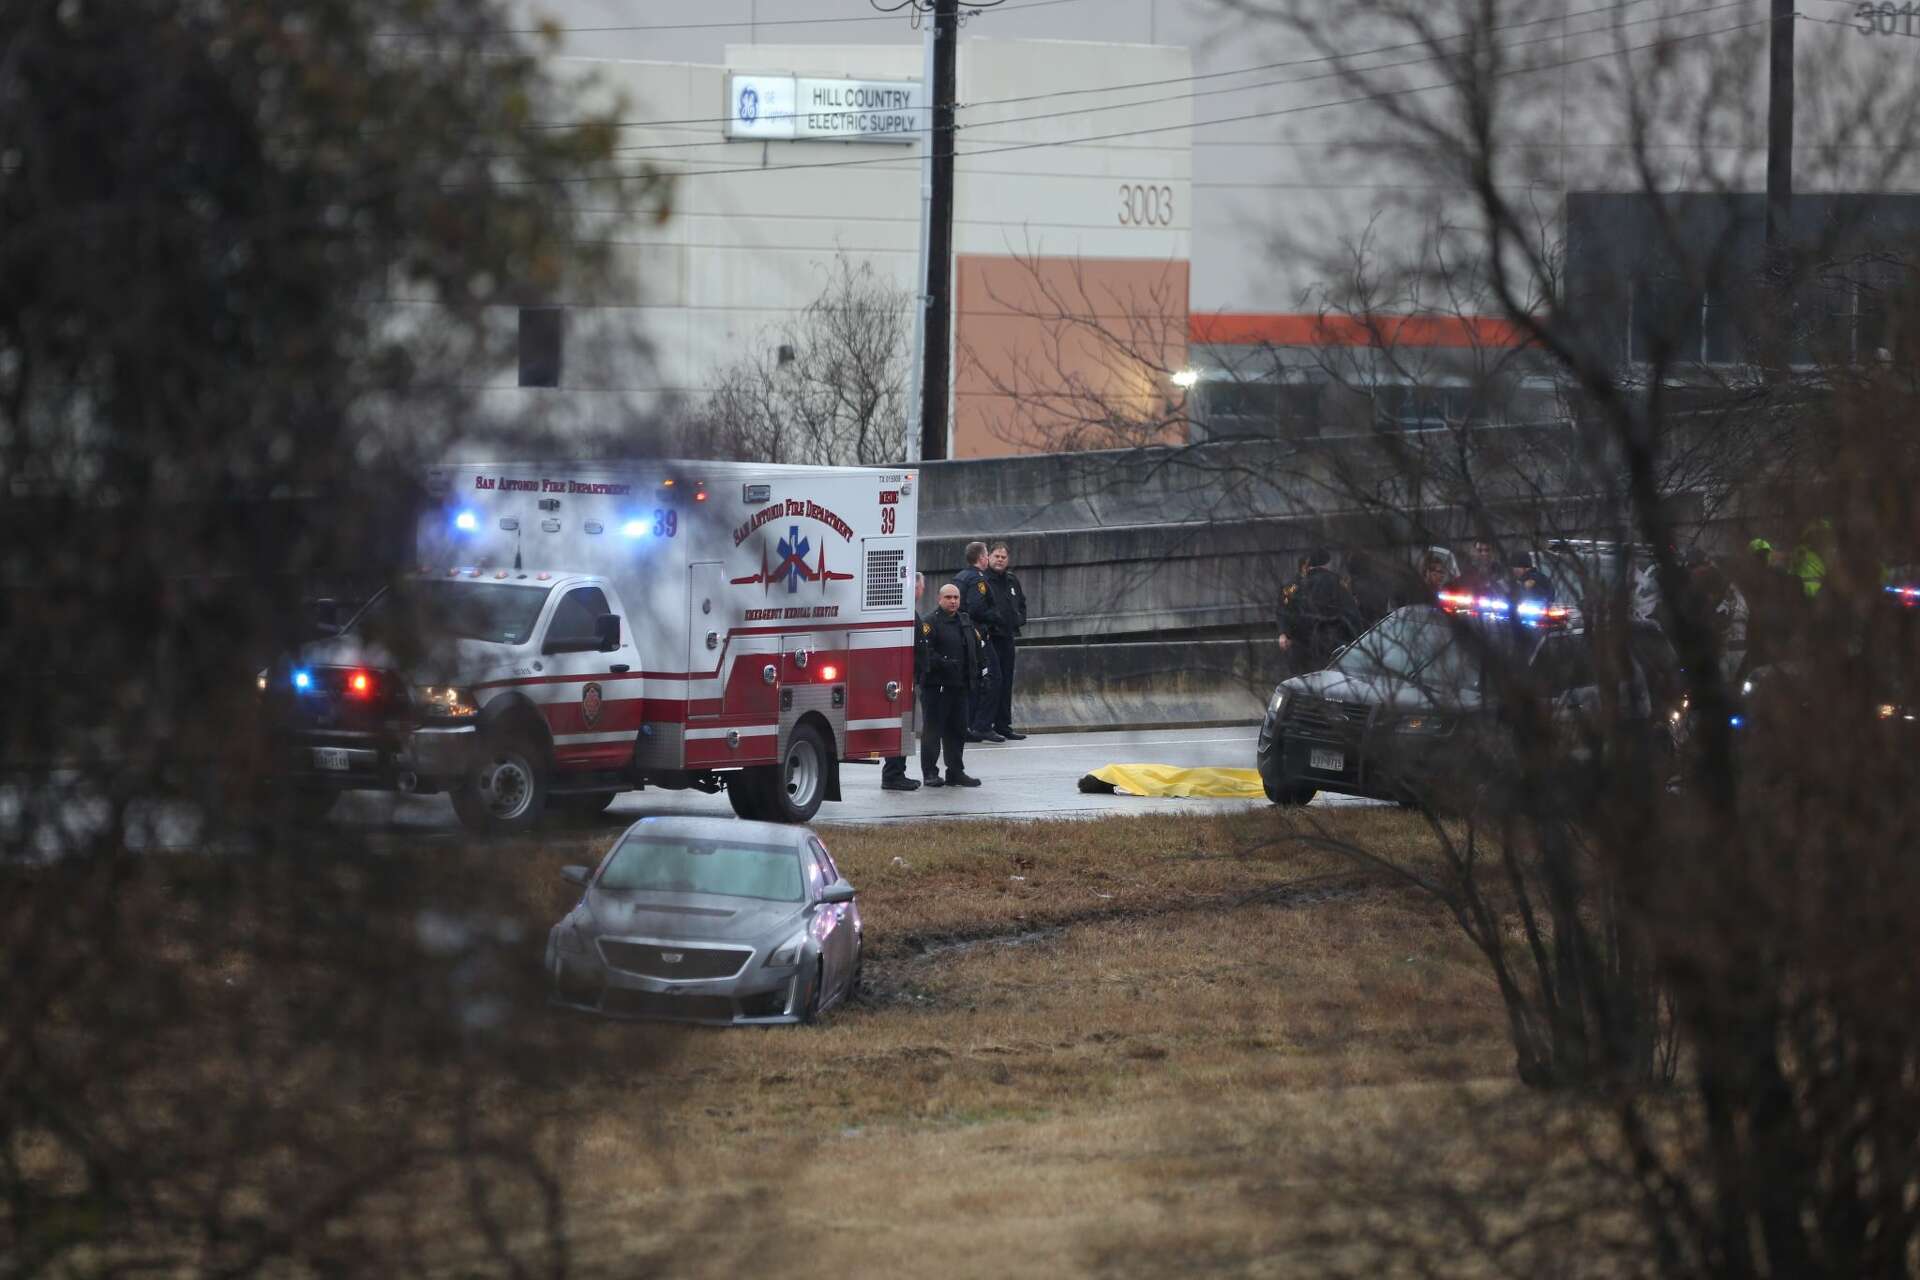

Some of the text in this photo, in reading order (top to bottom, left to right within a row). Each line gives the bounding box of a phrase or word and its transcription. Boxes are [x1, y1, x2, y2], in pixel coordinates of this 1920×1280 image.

[813, 88, 912, 108] HILL COUNTRY
[808, 114, 867, 130] ELECTRIC
[870, 115, 915, 132] SUPPLY
[1118, 184, 1173, 226] 3003
[475, 476, 631, 496] SAN ANTONIO FIRE DEPARTMENT
[652, 509, 677, 538] 39
[733, 498, 854, 548] SAN ANTONIO FIRE DEPARTMENT
[881, 507, 896, 535] 39
[744, 605, 839, 621] EMERGENCY MEDICAL SERVICE
